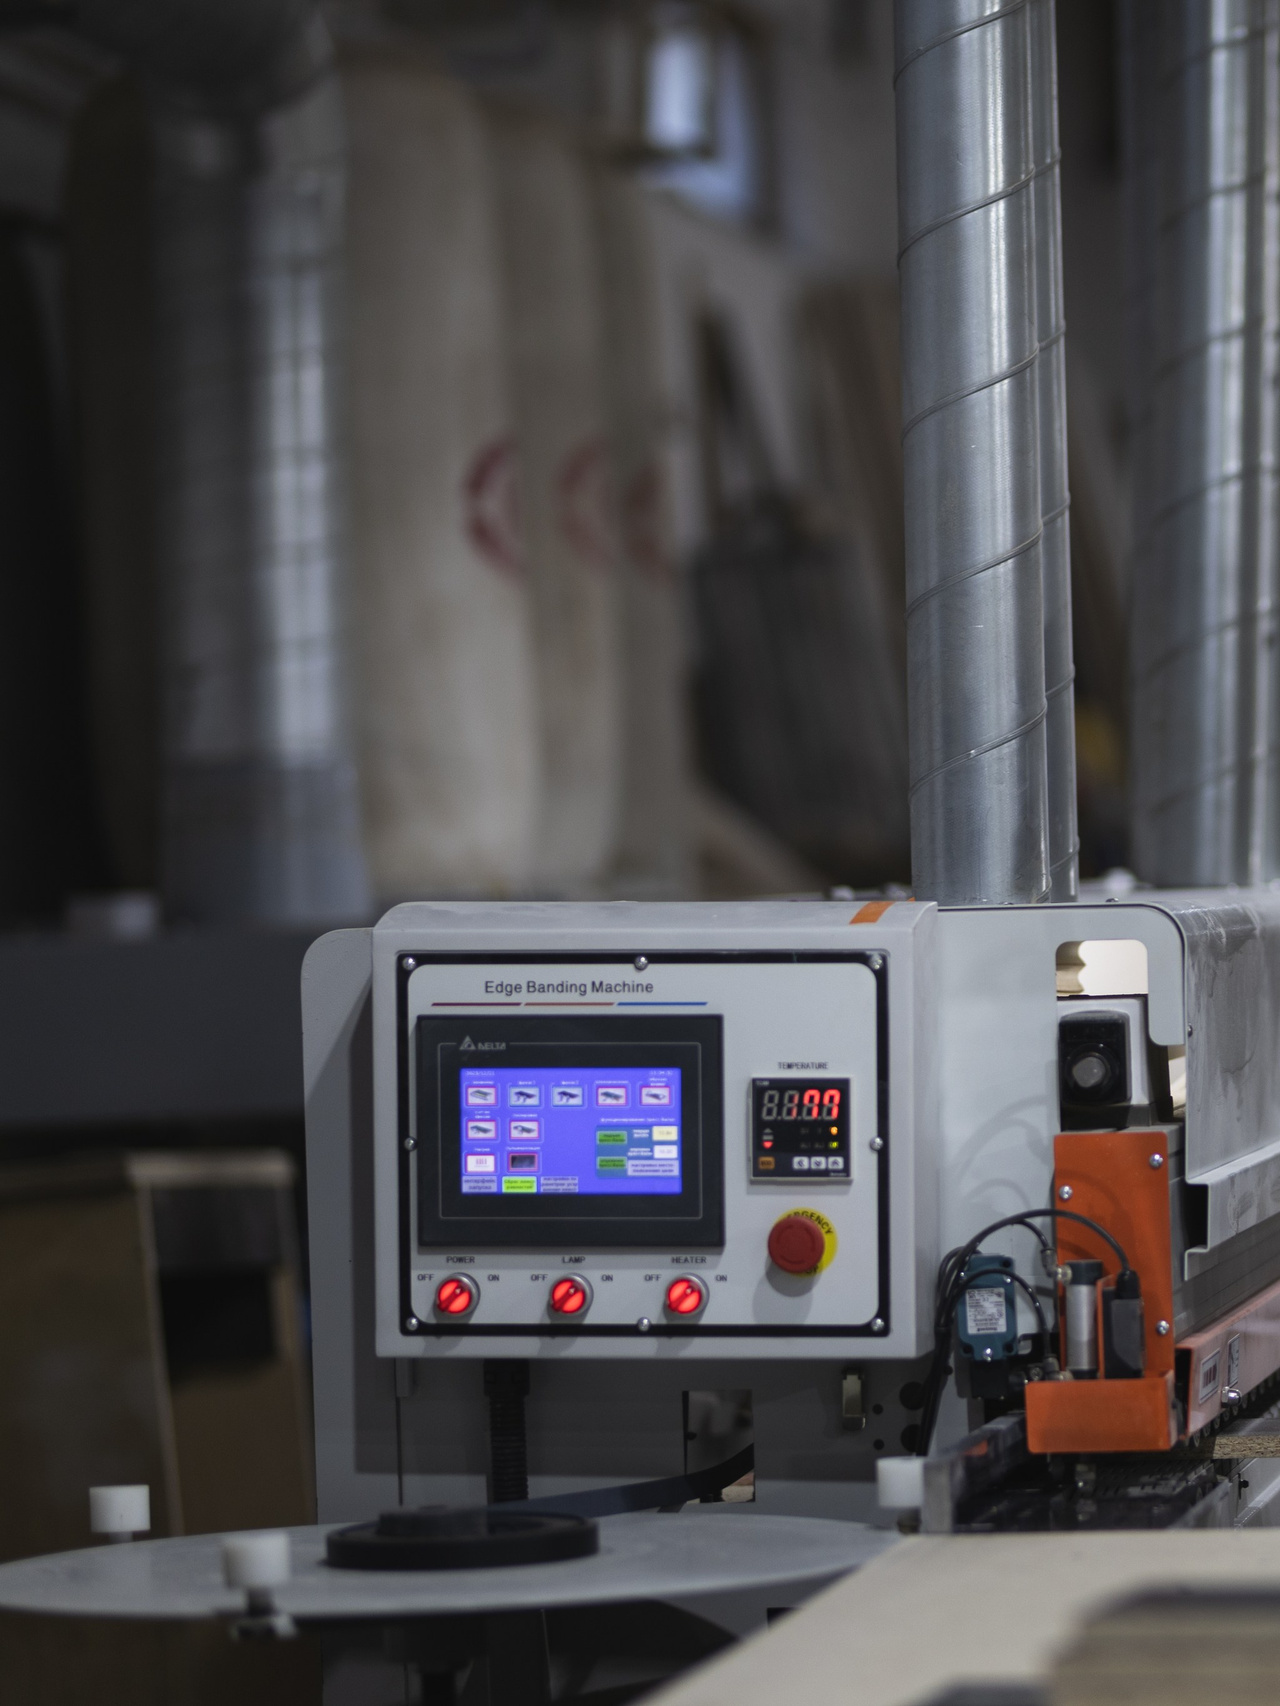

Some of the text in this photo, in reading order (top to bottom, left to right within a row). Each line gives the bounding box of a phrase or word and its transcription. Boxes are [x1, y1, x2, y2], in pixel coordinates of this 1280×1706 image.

[484, 980, 654, 997] Edge Banding Machine
[777, 1061, 829, 1070] TEMPERATURE
[790, 1088, 841, 1120] 177
[446, 1255, 476, 1264] POWER
[561, 1255, 586, 1264] LAMP
[671, 1256, 707, 1264] HEATER
[416, 1273, 500, 1281] OFF ON
[530, 1273, 614, 1282] OFF ON
[644, 1274, 728, 1282] OFF ON
